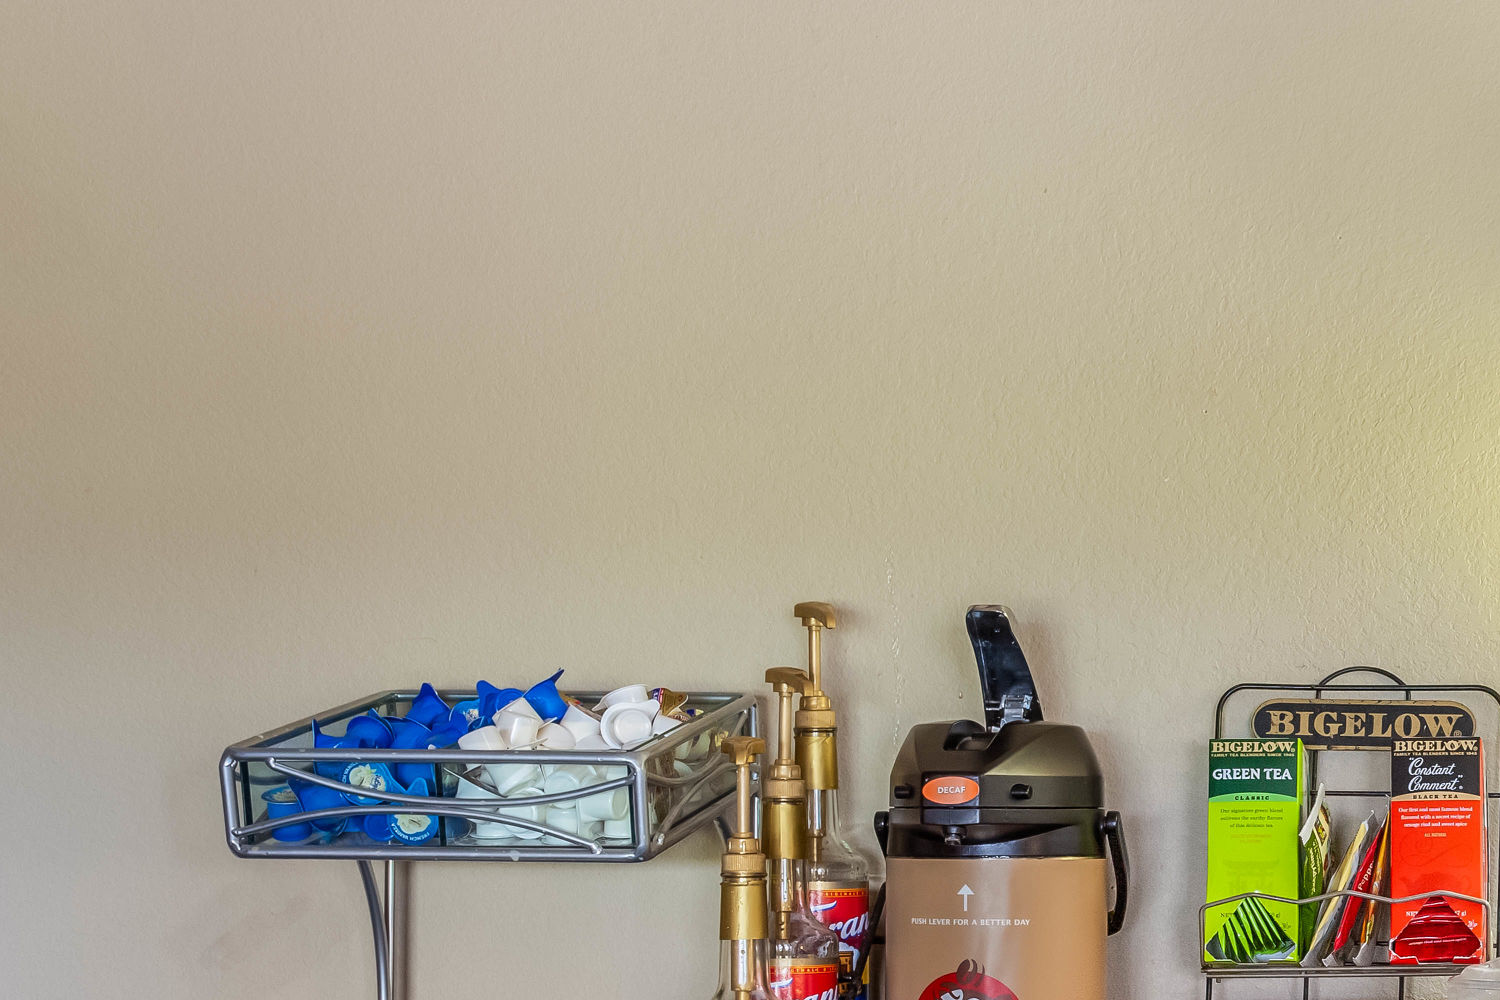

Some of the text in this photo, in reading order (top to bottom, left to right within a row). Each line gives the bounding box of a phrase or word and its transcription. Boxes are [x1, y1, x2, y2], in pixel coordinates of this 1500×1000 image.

[1265, 710, 1463, 738] BIGELOW
[1211, 741, 1295, 753] BIGELOW
[1394, 740, 1478, 752] BIGELOW
[1212, 768, 1293, 781] GREEN TEA
[937, 785, 967, 794] DECAF
[911, 918, 1031, 926] PUSH LEVER FOR A BETTER DAY
